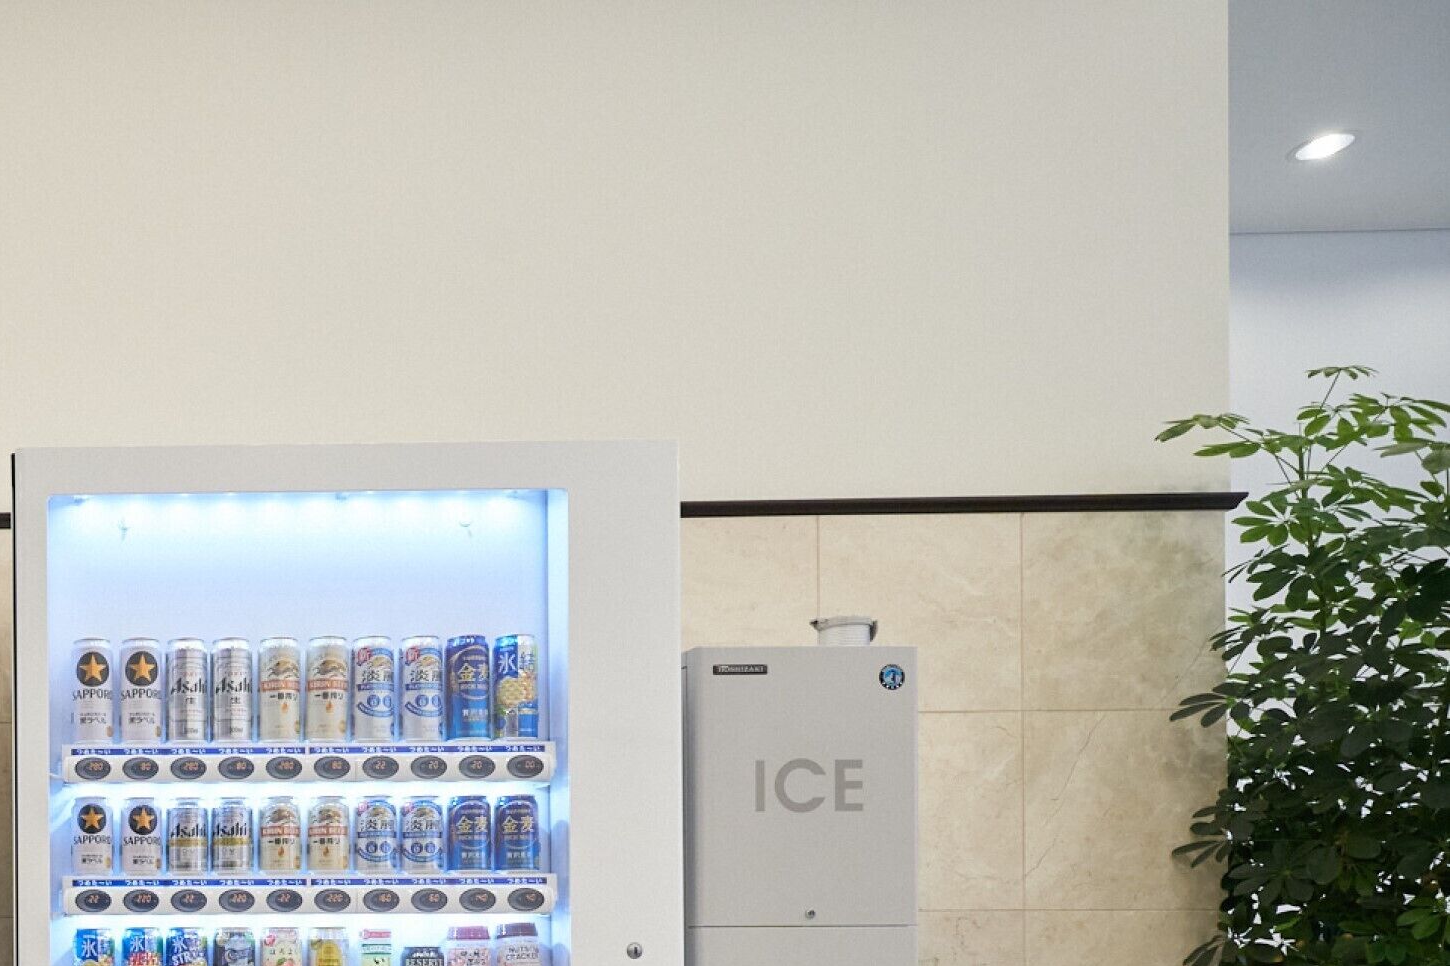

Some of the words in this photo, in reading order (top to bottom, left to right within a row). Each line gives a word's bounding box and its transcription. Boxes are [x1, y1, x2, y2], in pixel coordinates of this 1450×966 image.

[755, 758, 863, 813] ICE
[456, 815, 488, 833] 金麦
[502, 815, 534, 833] 金麦
